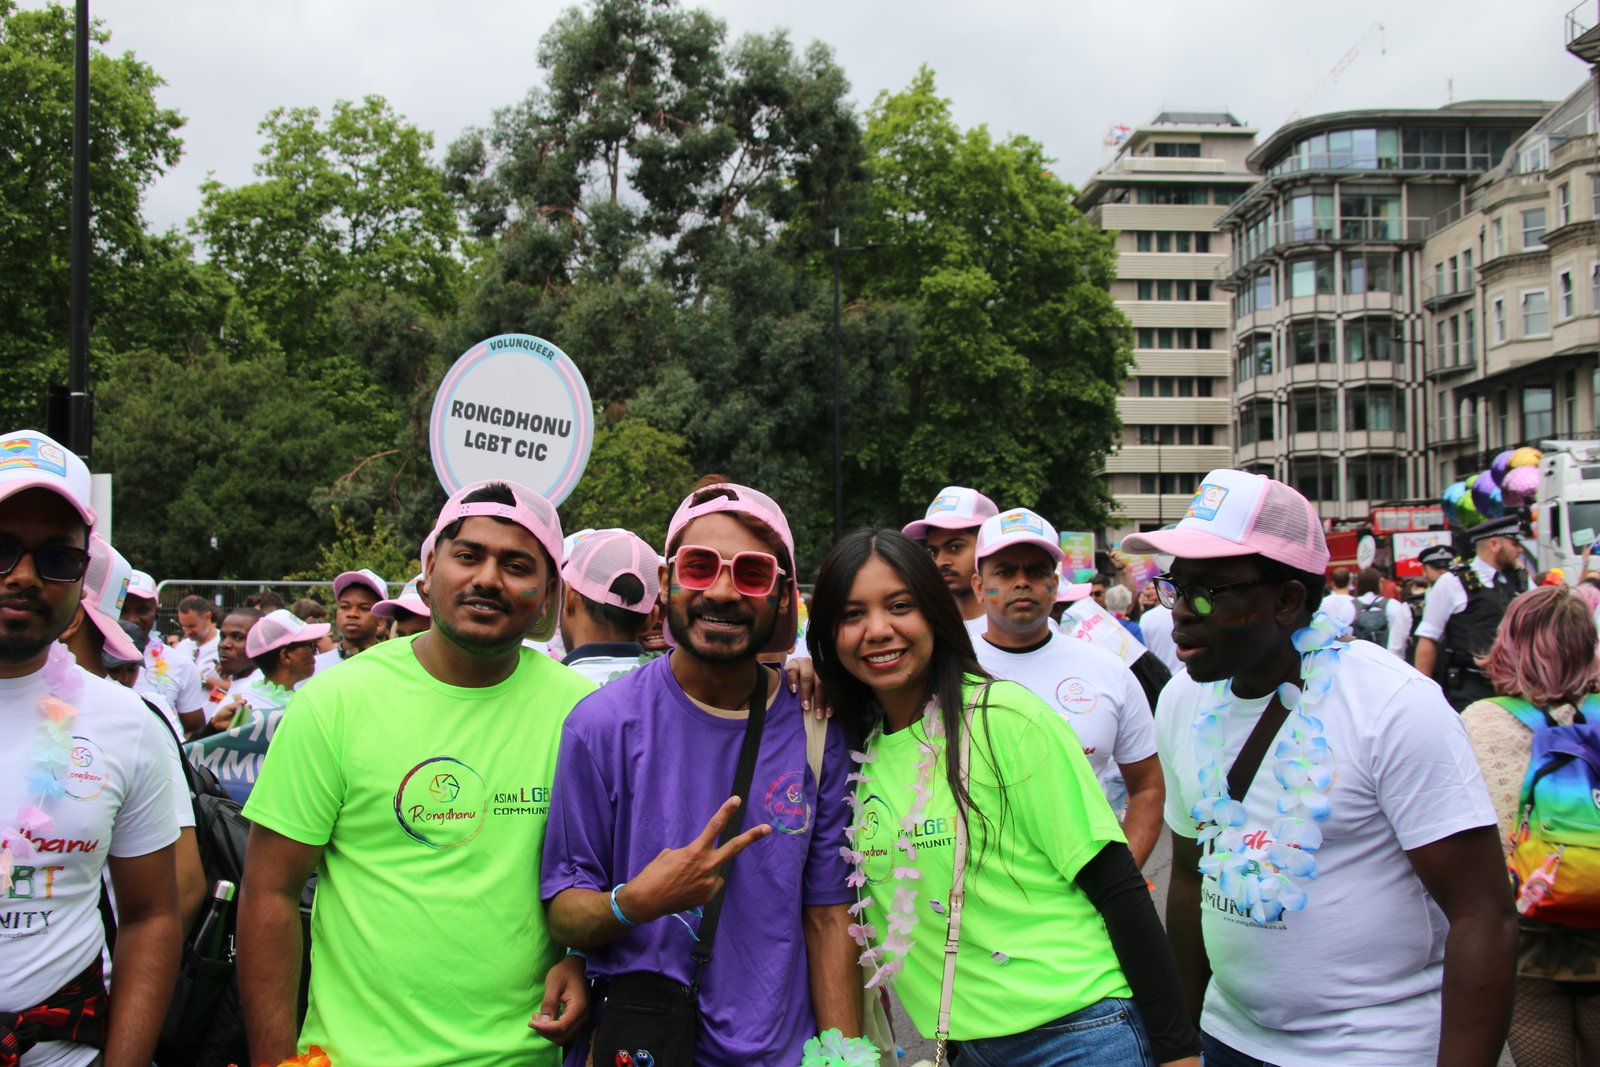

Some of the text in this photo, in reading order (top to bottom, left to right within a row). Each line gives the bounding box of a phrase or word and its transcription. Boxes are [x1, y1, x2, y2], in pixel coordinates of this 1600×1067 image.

[489, 338, 555, 361] VOLUNQUEER
[451, 400, 572, 438] RONGDHONU
[464, 430, 548, 462] LGBT CIC
[494, 787, 552, 803] ASIAN LGB
[408, 804, 476, 825] Rongdhanu
